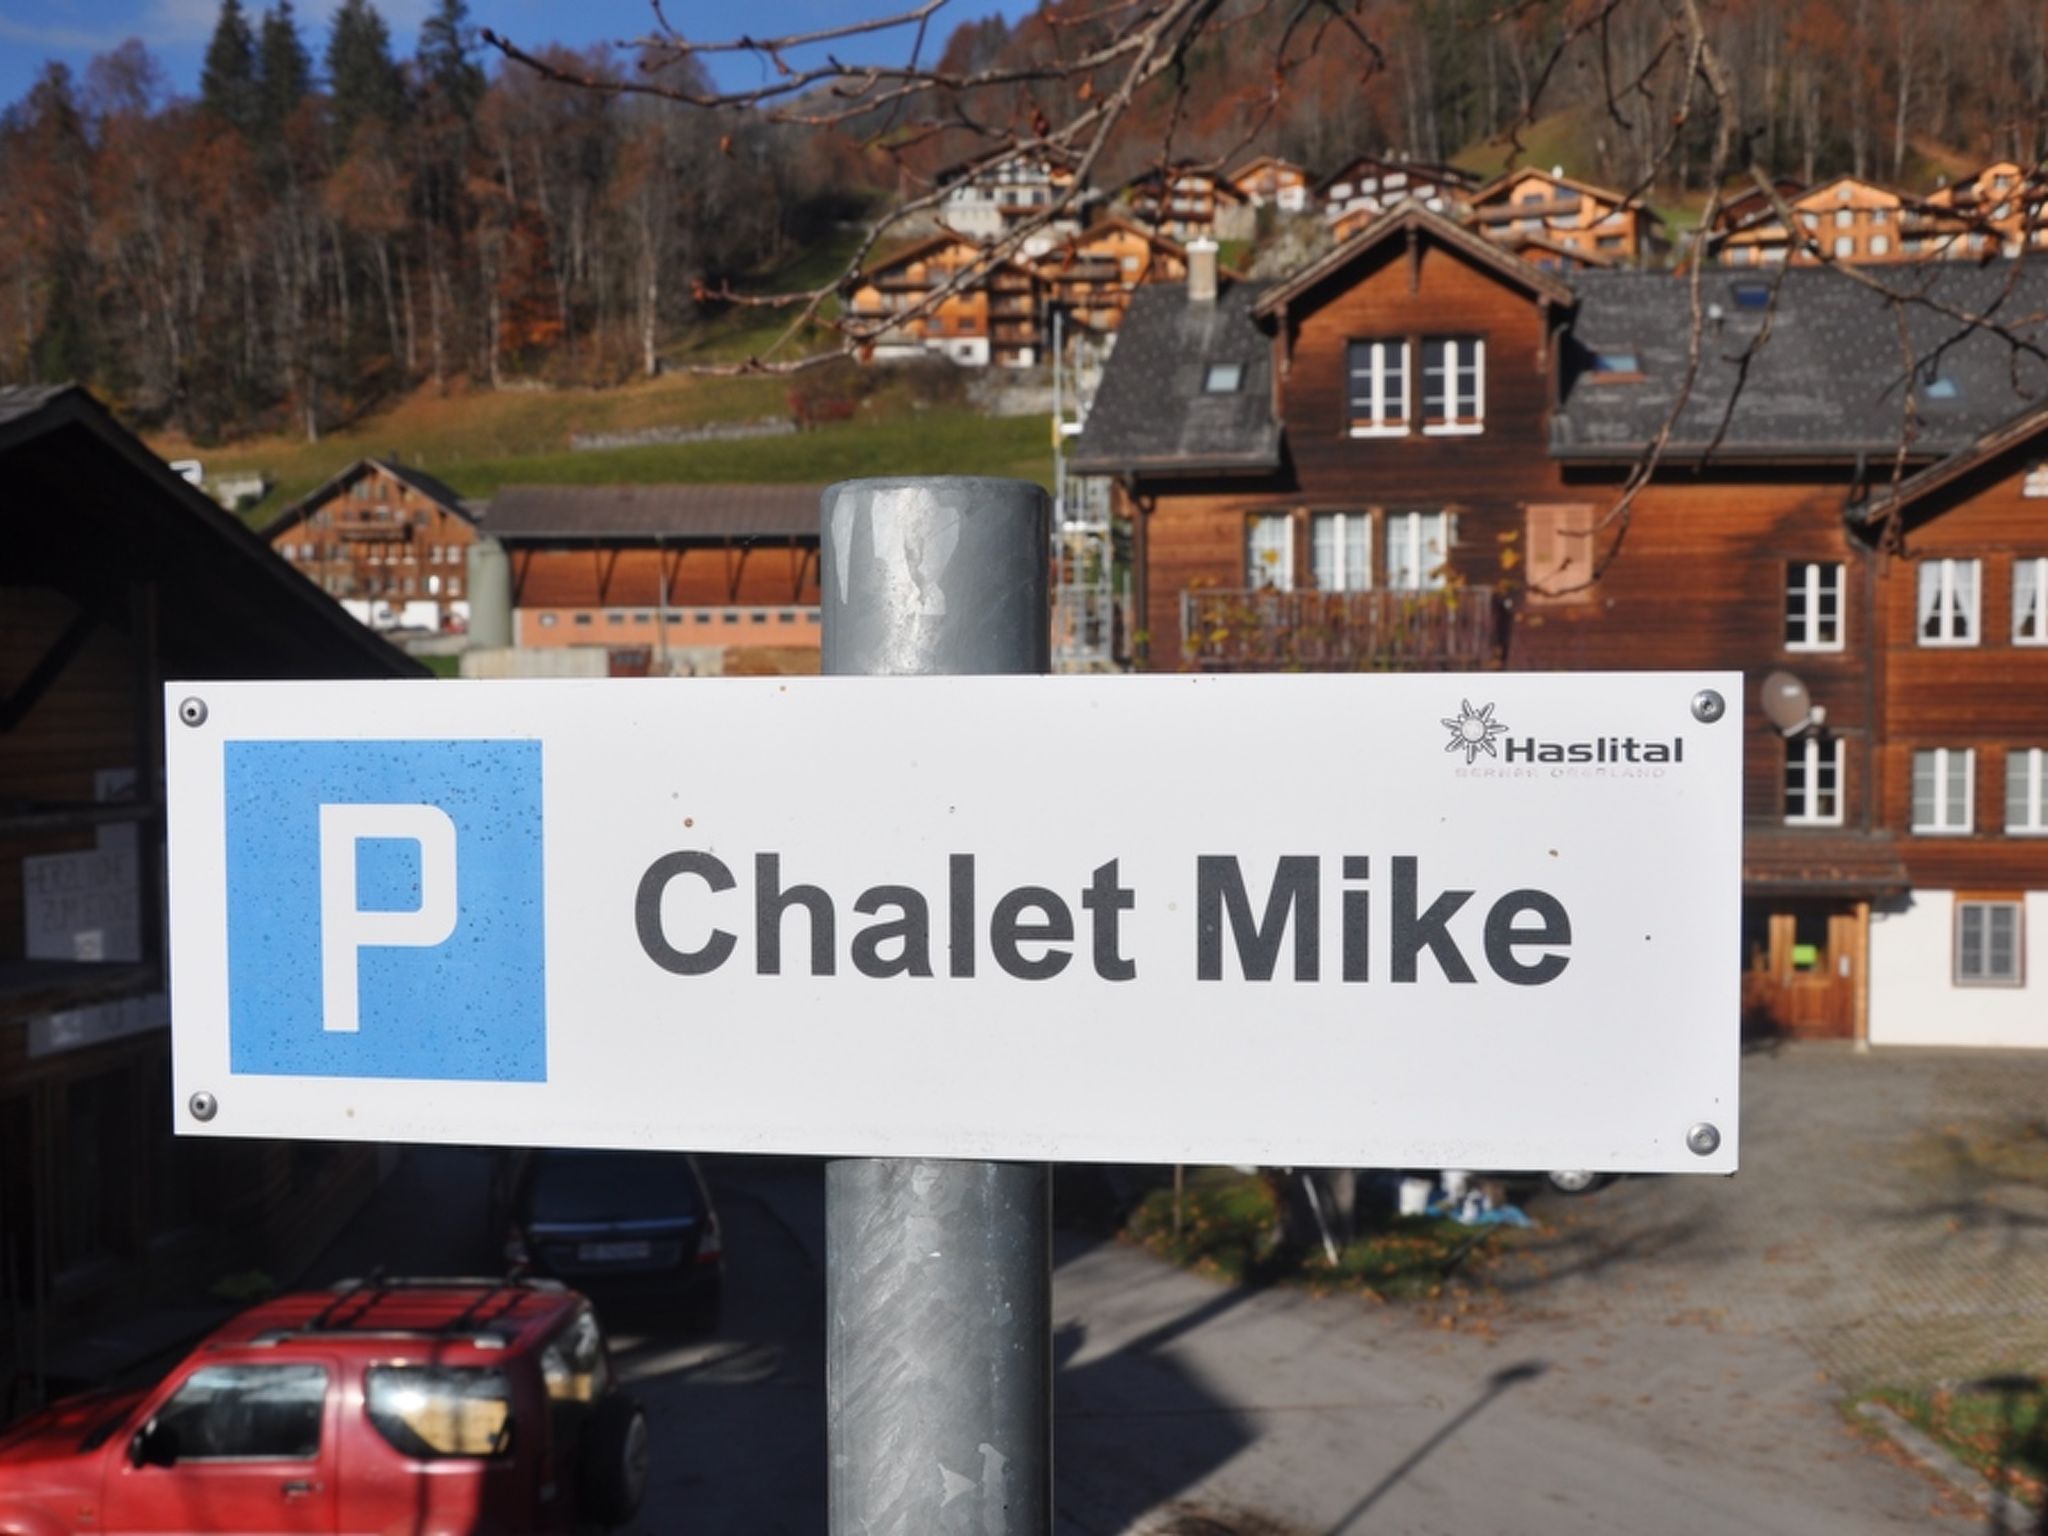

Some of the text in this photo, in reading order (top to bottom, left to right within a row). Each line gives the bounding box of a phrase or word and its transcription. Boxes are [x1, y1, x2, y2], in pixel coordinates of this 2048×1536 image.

[1505, 737, 1683, 763] Haslital
[320, 804, 458, 1032] P
[634, 850, 1573, 986] Chalet Mike
